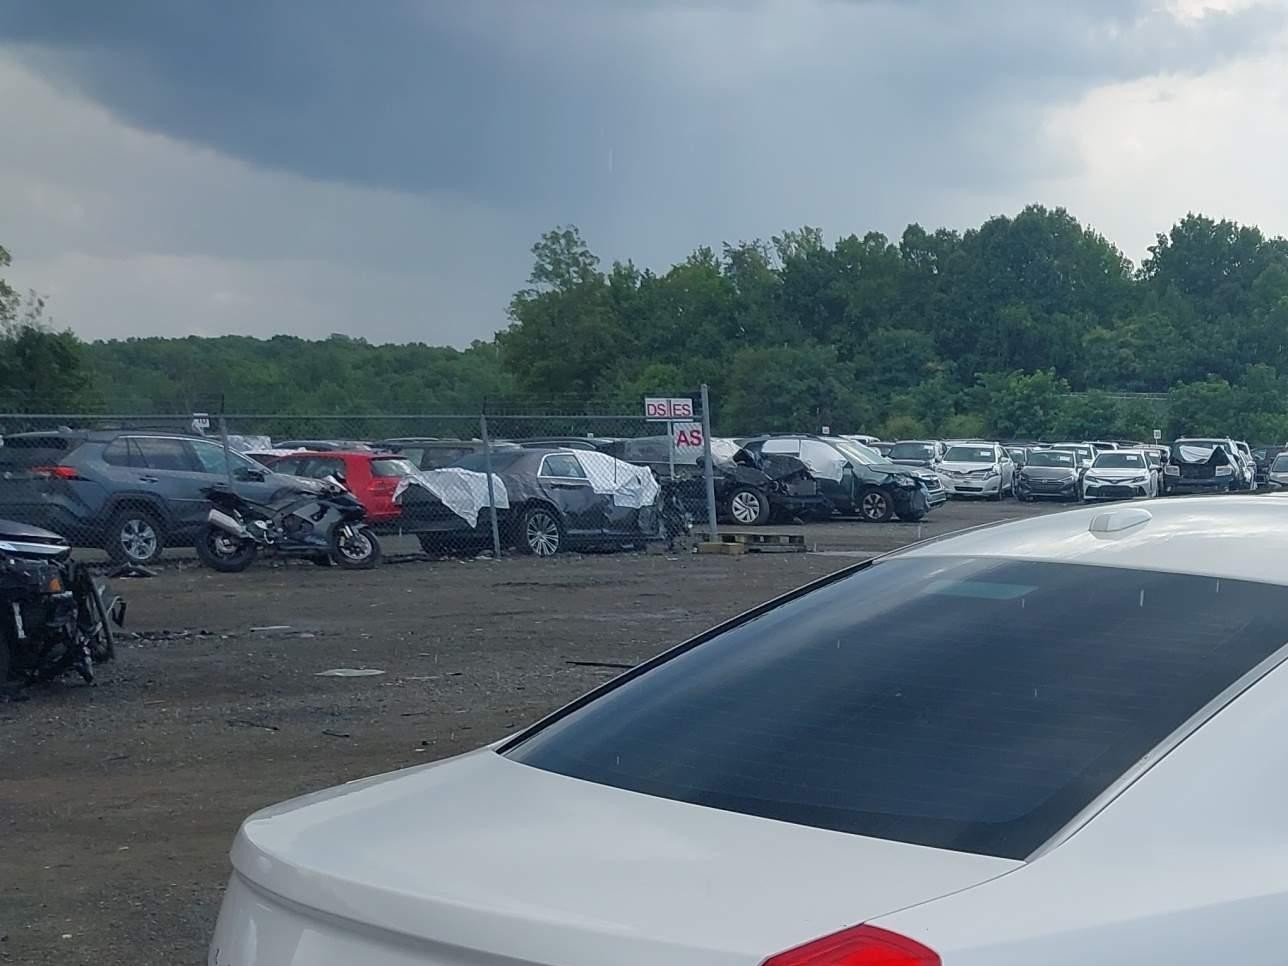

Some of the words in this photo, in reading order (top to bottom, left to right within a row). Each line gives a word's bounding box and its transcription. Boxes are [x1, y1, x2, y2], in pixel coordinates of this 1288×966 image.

[647, 403, 667, 416] DS
[673, 403, 691, 416] ES
[676, 429, 702, 448] AS
